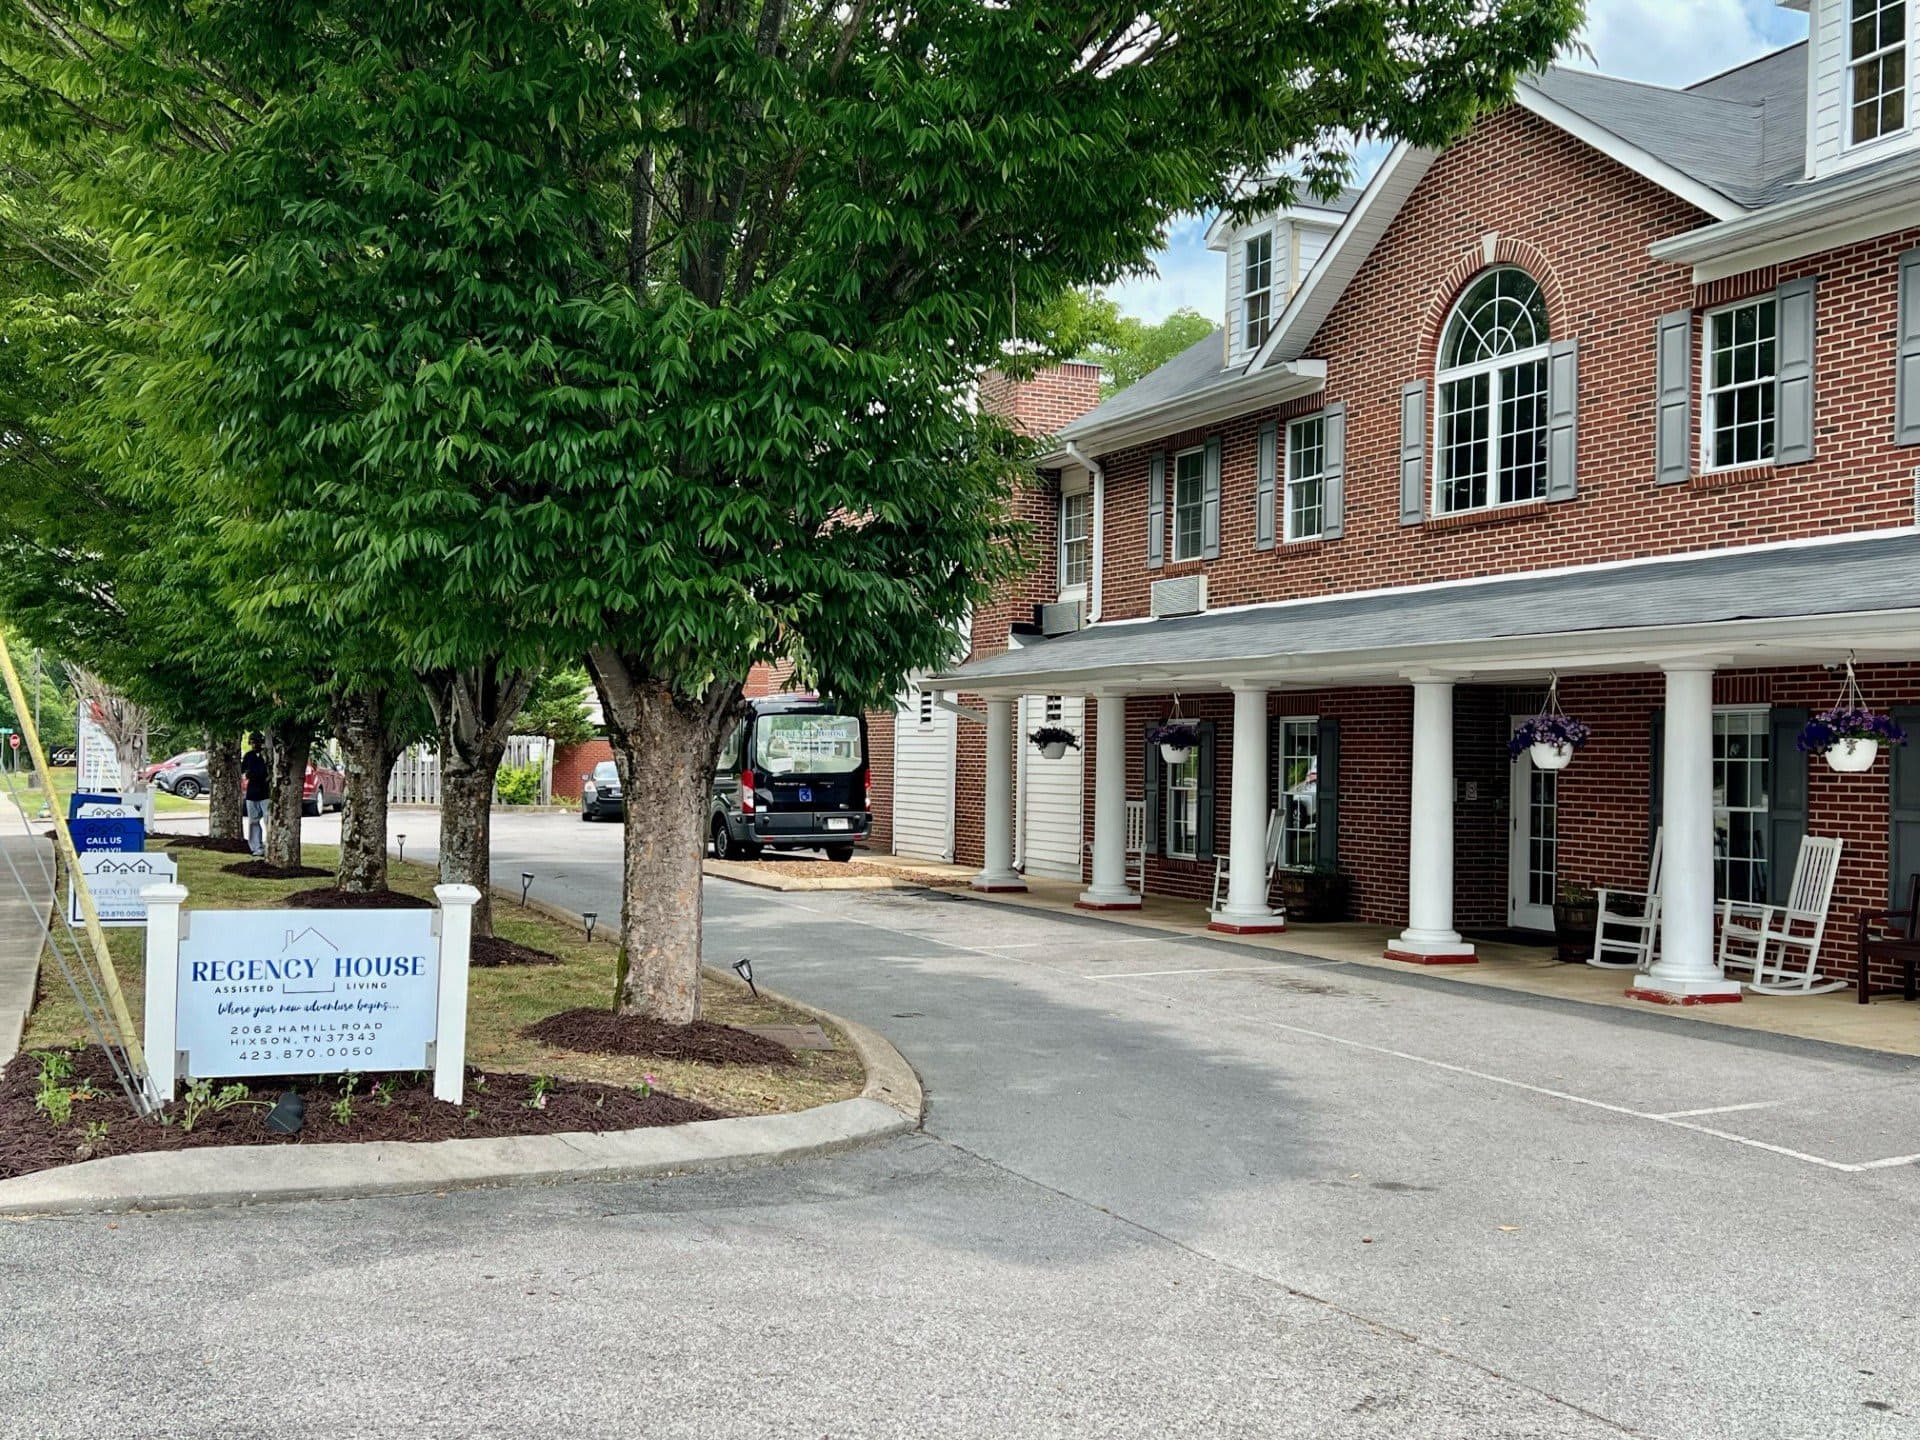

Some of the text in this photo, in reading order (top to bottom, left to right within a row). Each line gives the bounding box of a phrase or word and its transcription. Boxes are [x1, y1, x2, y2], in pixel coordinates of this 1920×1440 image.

[192, 956, 426, 982] REGENCY HOUSE
[215, 982, 388, 994] ASSISTED LIVING
[217, 1001, 250, 1015] Where
[253, 1004, 278, 1018] your
[279, 1003, 300, 1012] new
[303, 1000, 353, 1012] adventure
[230, 1022, 383, 1035] 2062 HAMILL ROAD
[303, 1035, 321, 1044] TN
[326, 1032, 376, 1043] 37343
[239, 1046, 373, 1061] 423.870.0050
